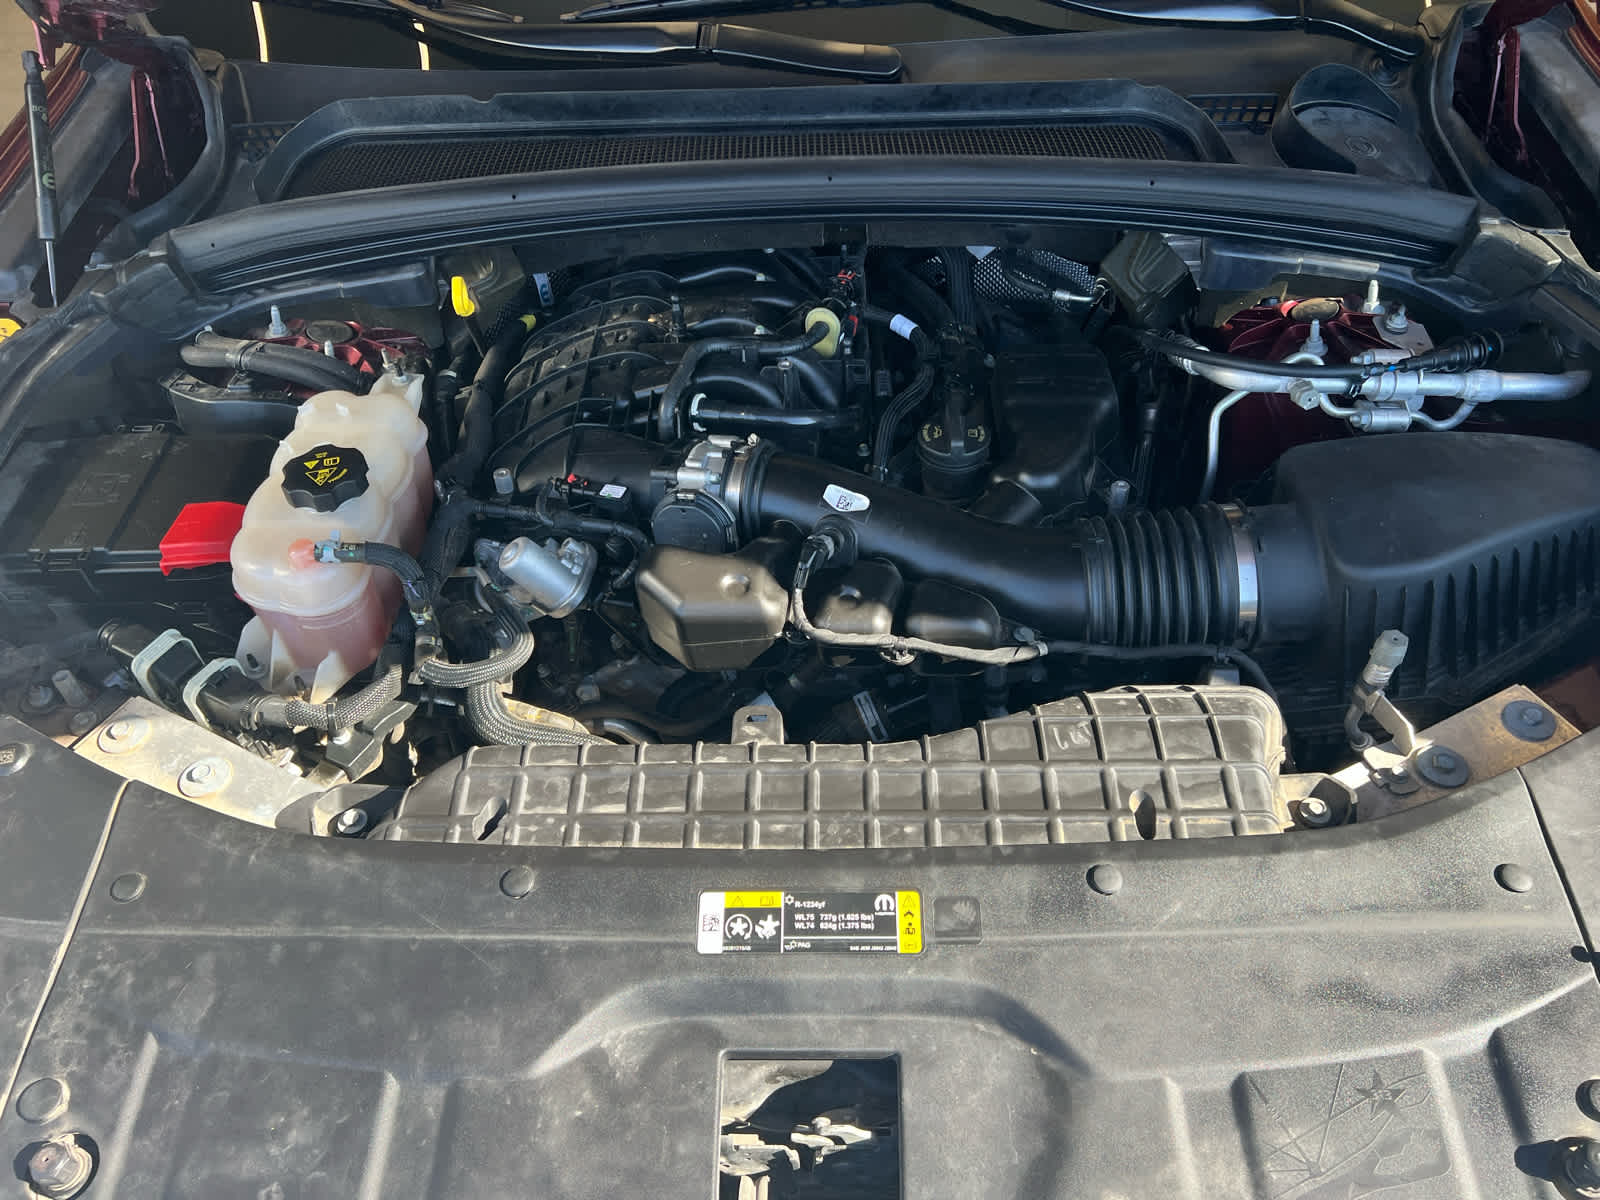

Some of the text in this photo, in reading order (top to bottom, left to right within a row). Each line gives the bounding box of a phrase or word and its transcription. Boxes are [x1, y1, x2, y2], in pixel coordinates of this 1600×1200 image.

[794, 901, 826, 910] R-1234yf
[794, 913, 815, 921] WL75
[860, 913, 875, 922] lbs)
[794, 921, 815, 929] WL74
[838, 921, 860, 930] (1.375
[860, 921, 875, 930] lbs)
